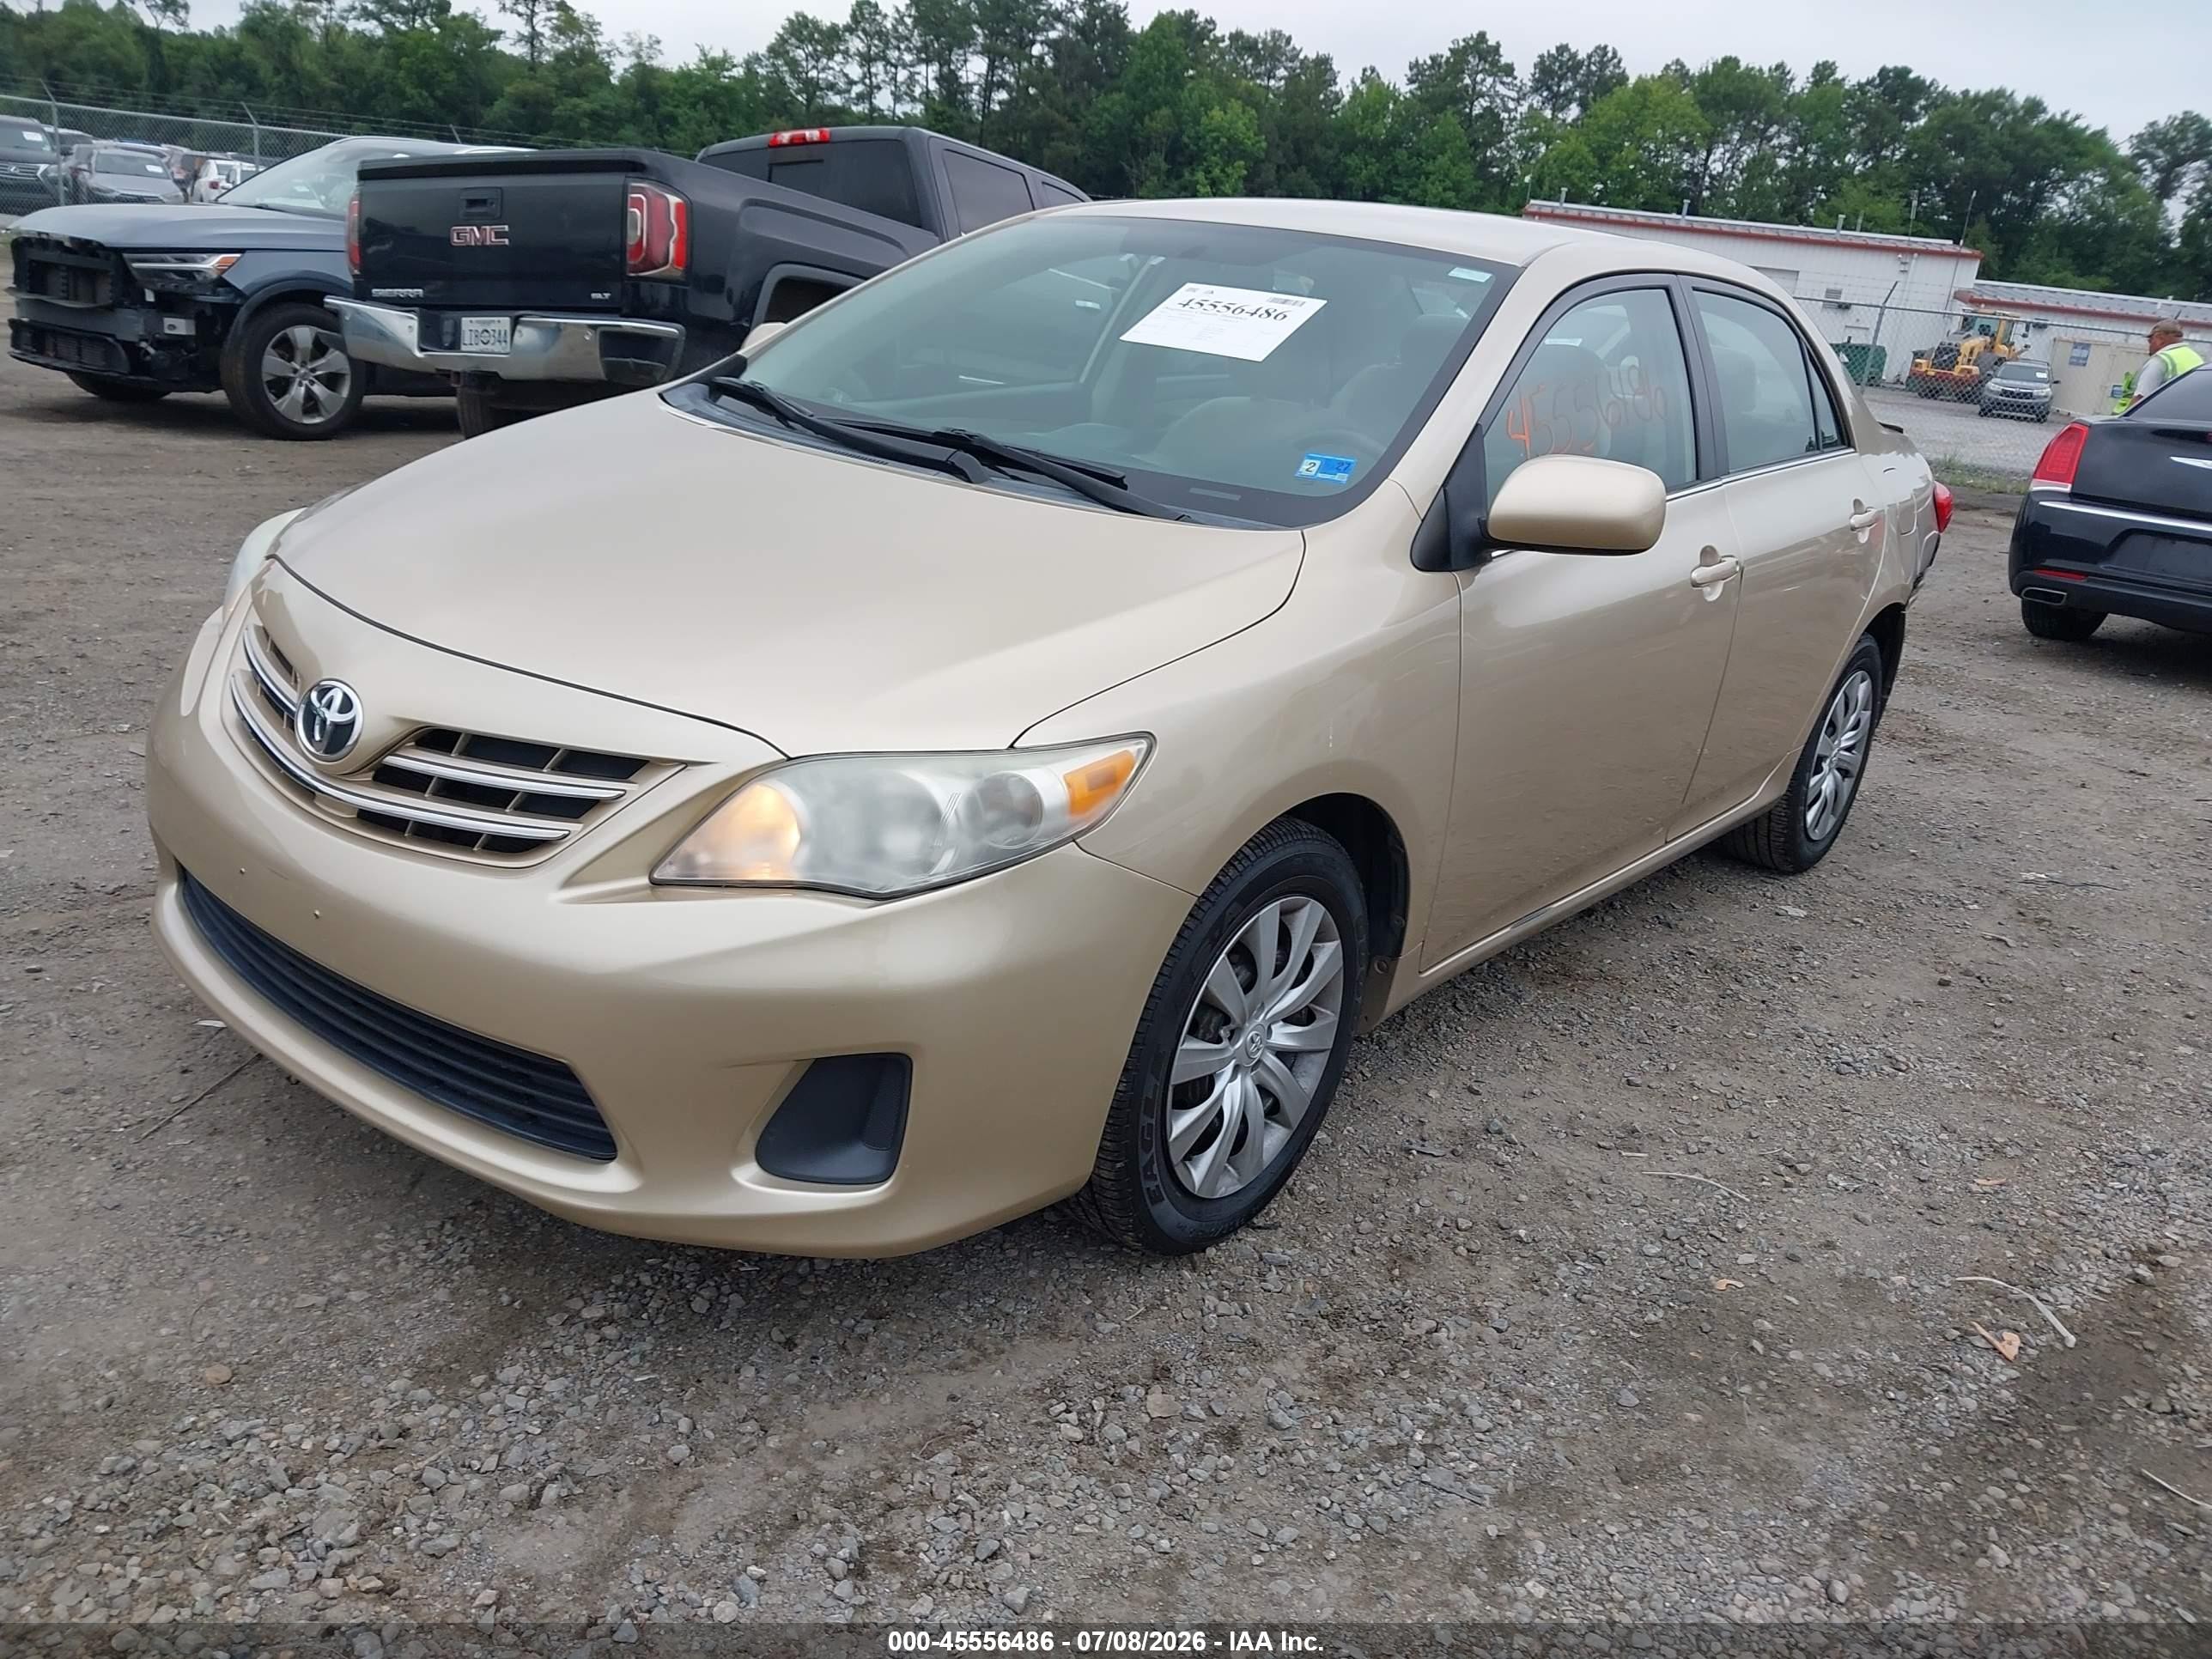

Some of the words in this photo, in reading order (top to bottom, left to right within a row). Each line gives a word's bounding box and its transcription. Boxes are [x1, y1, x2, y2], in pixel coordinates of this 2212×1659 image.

[450, 225, 509, 246] GMC
[371, 288, 424, 298] SIERRA
[1177, 297, 1291, 322] 45556486
[1305, 462, 1316, 472] 2
